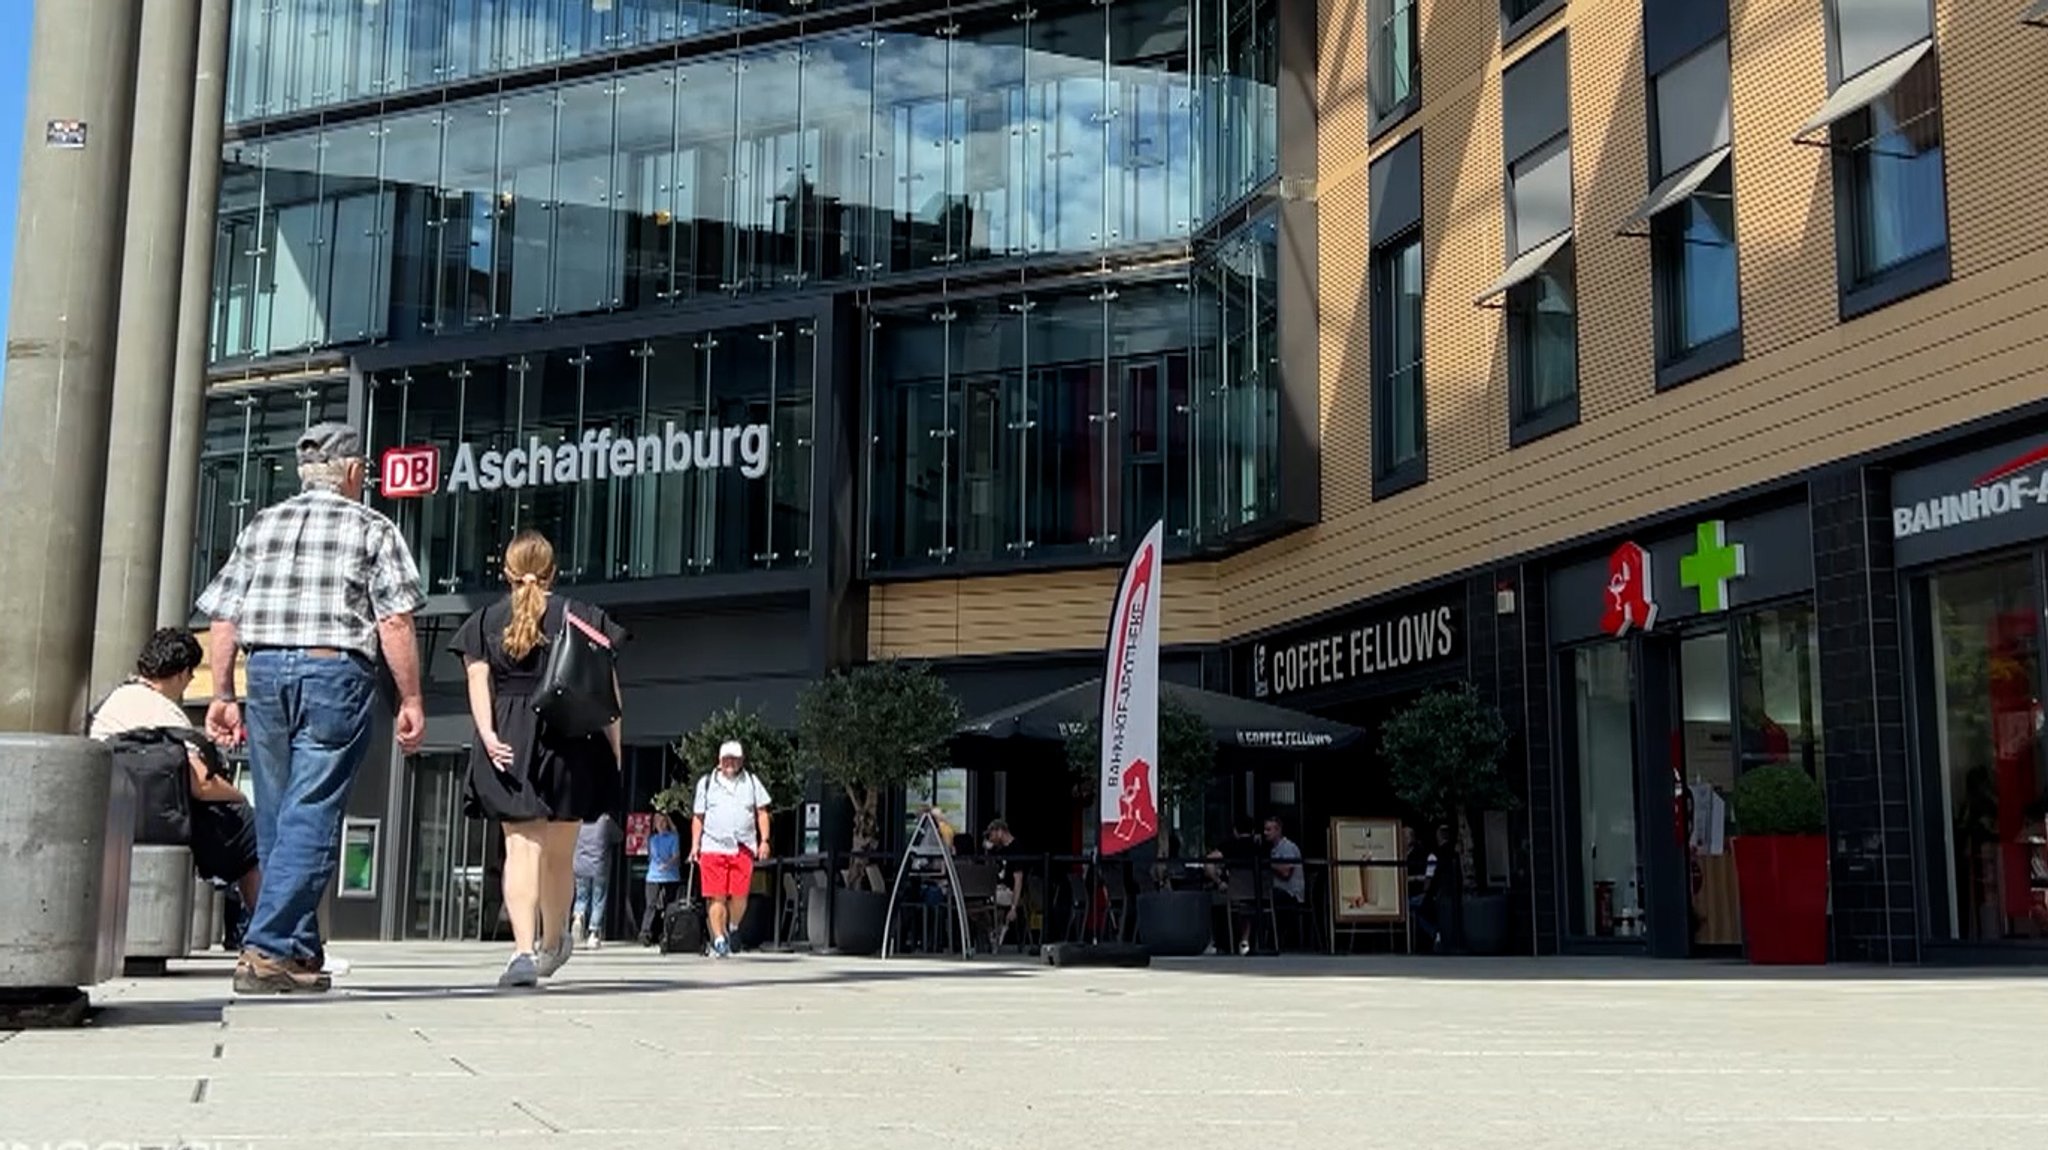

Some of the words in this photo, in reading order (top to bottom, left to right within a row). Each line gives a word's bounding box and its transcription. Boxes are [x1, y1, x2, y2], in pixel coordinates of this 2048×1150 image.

[388, 454, 432, 490] DB
[447, 421, 770, 492] Aschaffenburg
[1274, 636, 1344, 694] COFFEE
[1351, 606, 1451, 676] FELLOWS
[1108, 602, 1141, 787] BAHNHOF-APOTHEKE
